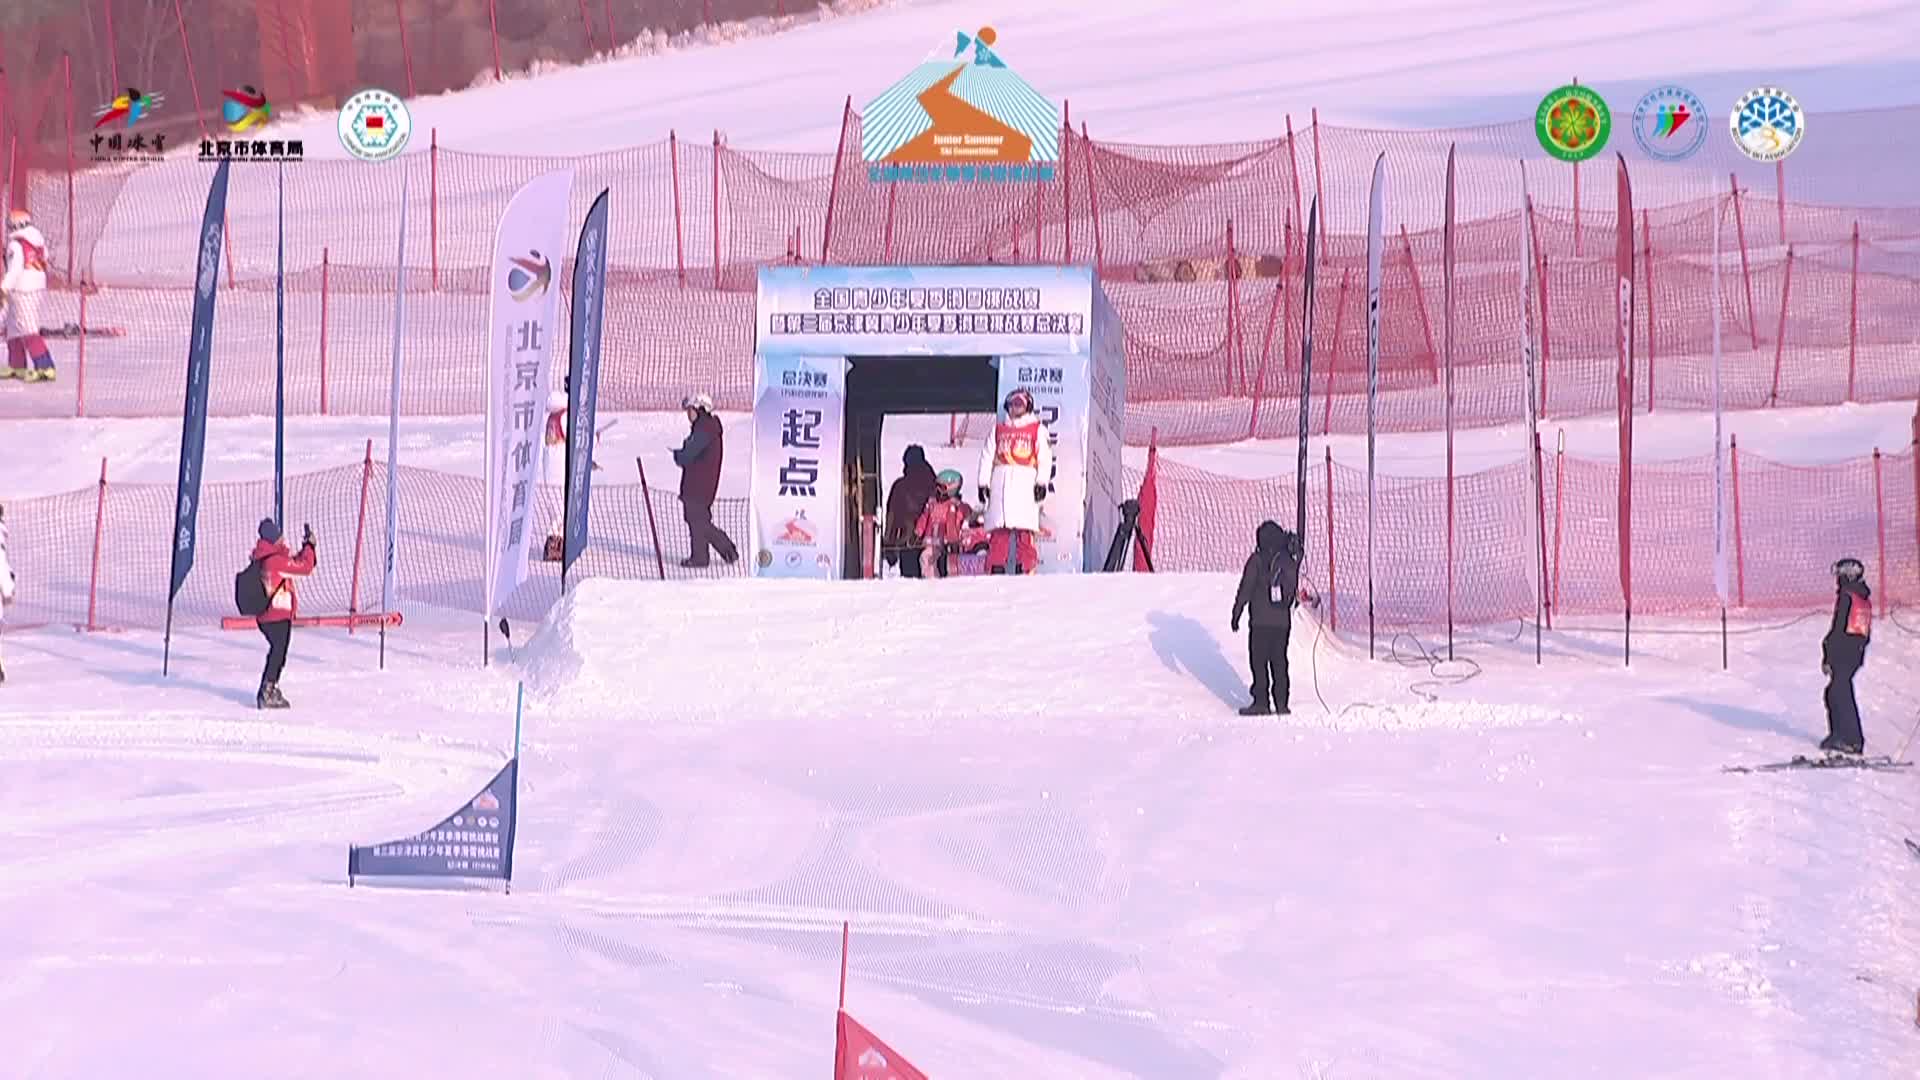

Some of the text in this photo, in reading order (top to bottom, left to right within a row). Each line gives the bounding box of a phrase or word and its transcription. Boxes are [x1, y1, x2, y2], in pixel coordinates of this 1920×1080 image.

[813, 287, 1041, 310] 全国青少年夏季滑雪挑战赛
[782, 371, 828, 387] 总决赛
[1018, 367, 1064, 382] 总决赛
[509, 320, 543, 546] 北京市体育局
[778, 408, 822, 497] 起点
